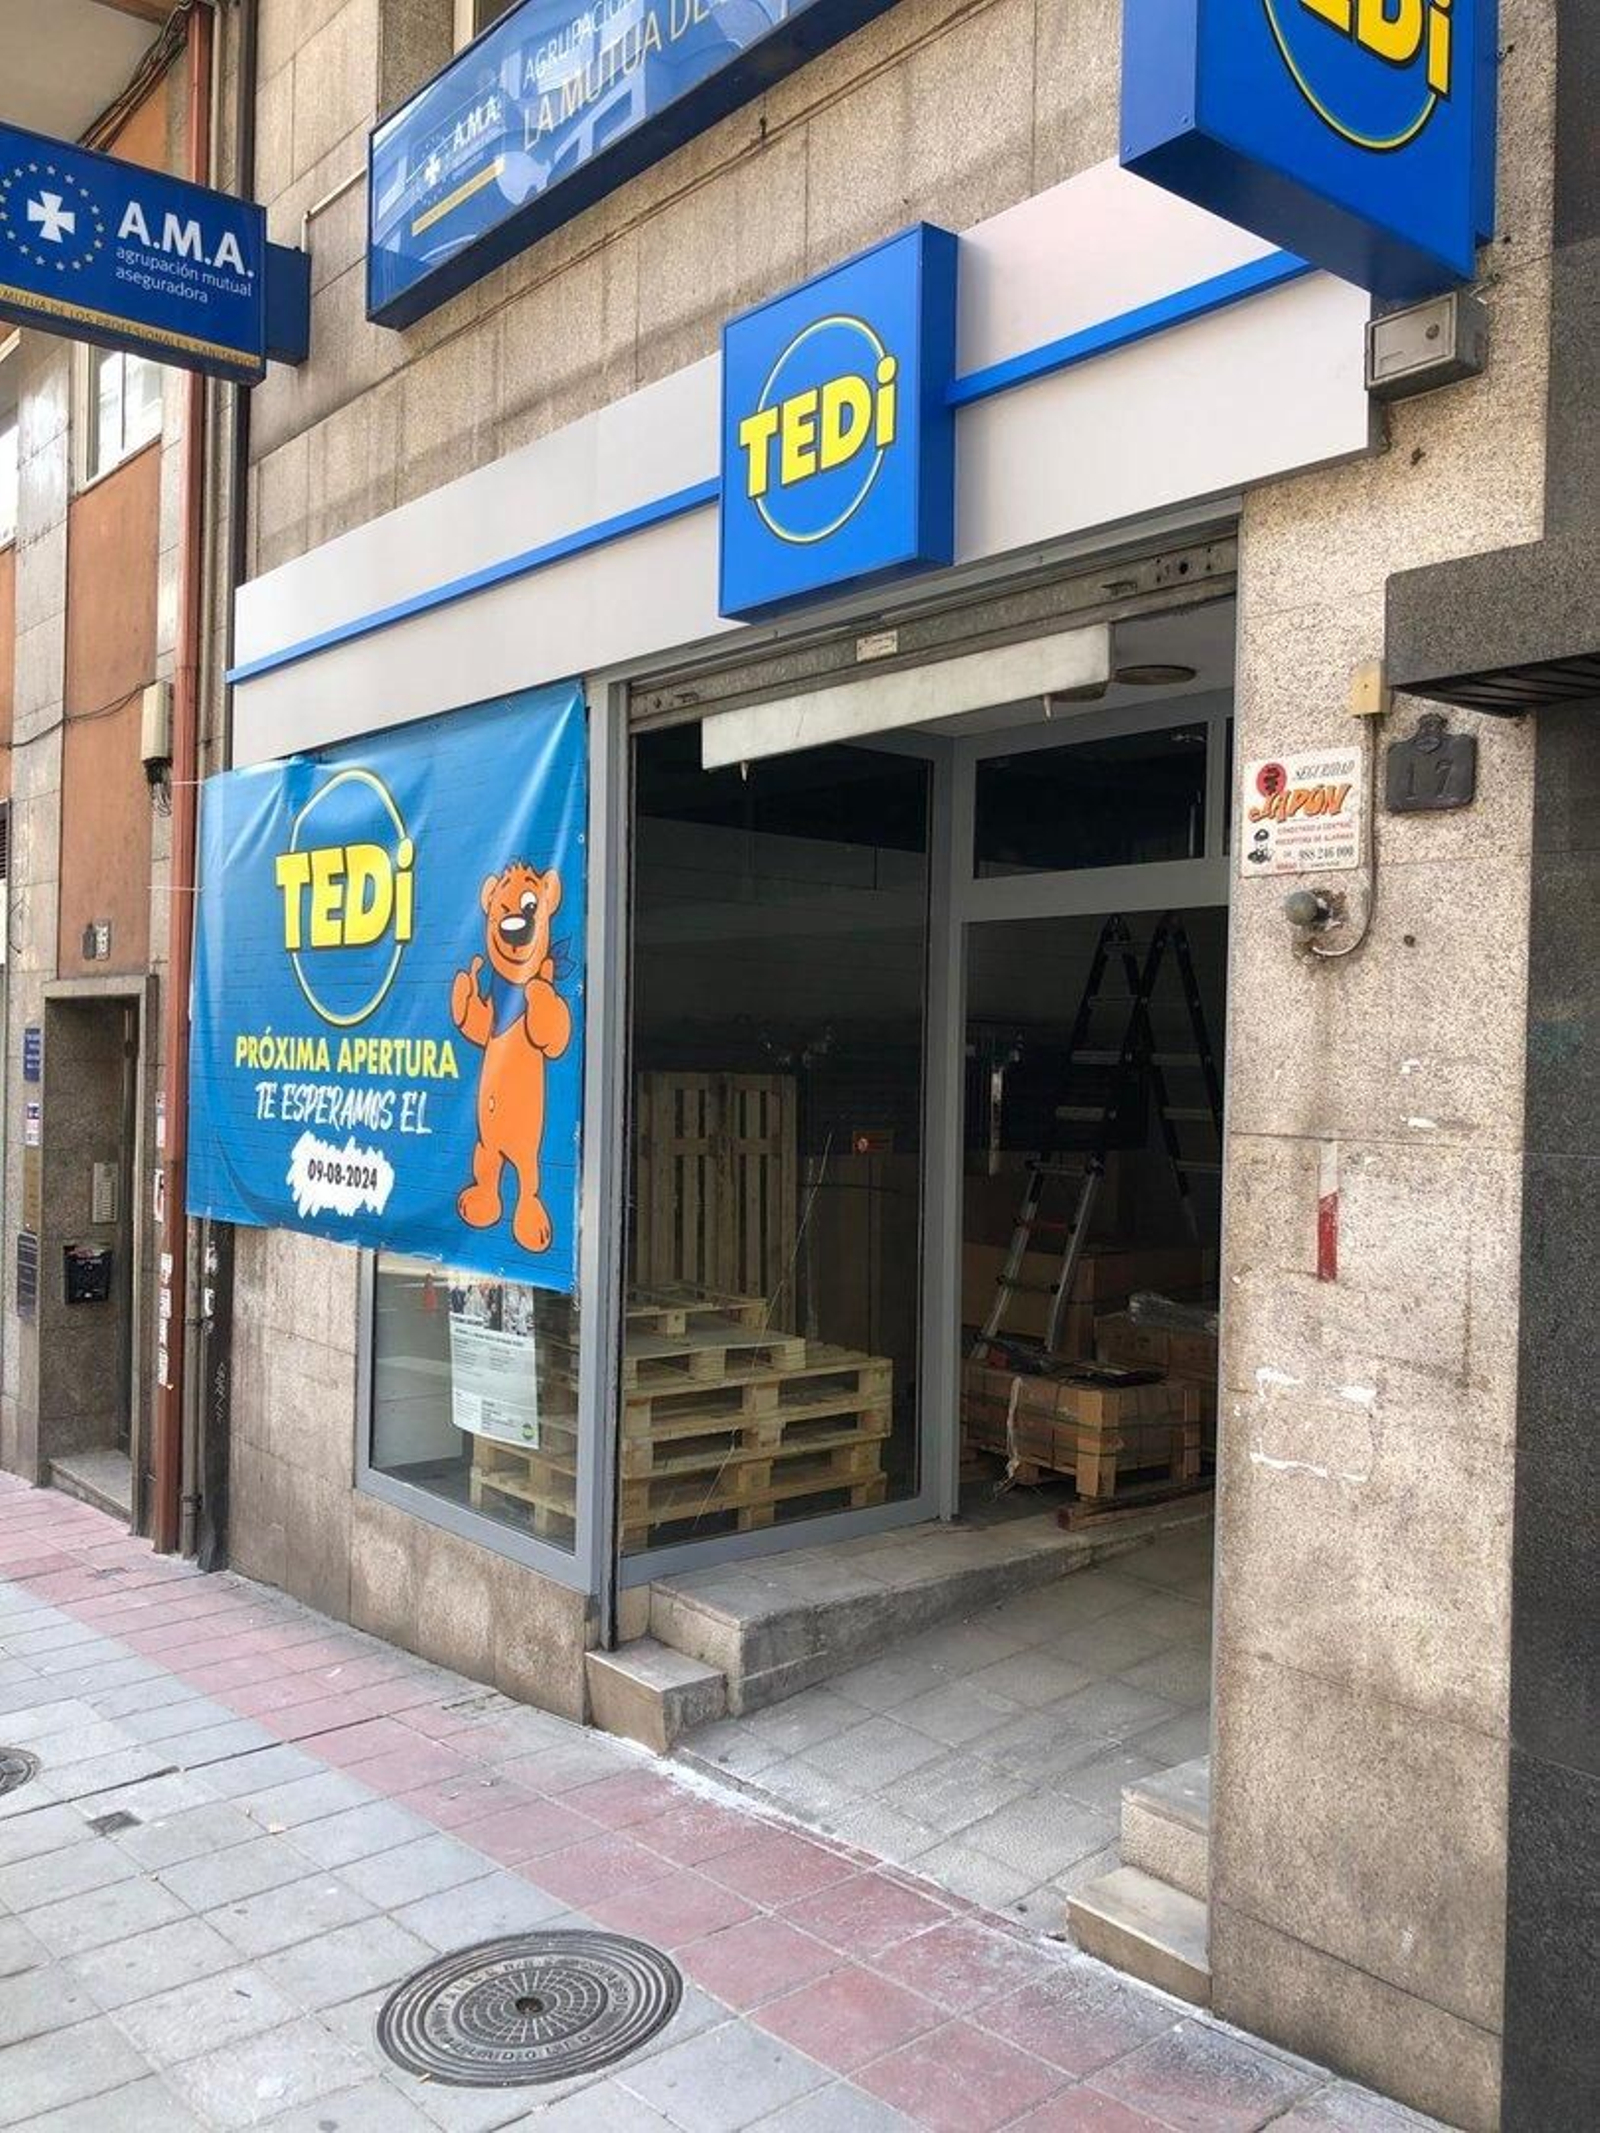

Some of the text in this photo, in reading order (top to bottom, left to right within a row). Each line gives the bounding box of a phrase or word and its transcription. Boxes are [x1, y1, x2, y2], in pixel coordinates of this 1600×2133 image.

[523, 93, 554, 150] LA
[560, 11, 662, 125] MUTUA
[116, 200, 255, 278] A.M.A.
[115, 265, 208, 303] aseguradora
[116, 247, 252, 297] agrupación mutual
[738, 354, 898, 500] TEDi
[1247, 783, 1353, 824] JAPÓN
[1404, 757, 1455, 800] 17
[275, 838, 415, 951] TEDi
[235, 1026, 460, 1079] PRÓXIMA APERTURA
[255, 1081, 432, 1135] TE ESPERAMOS EL
[307, 1156, 378, 1192] 09-08-2024
